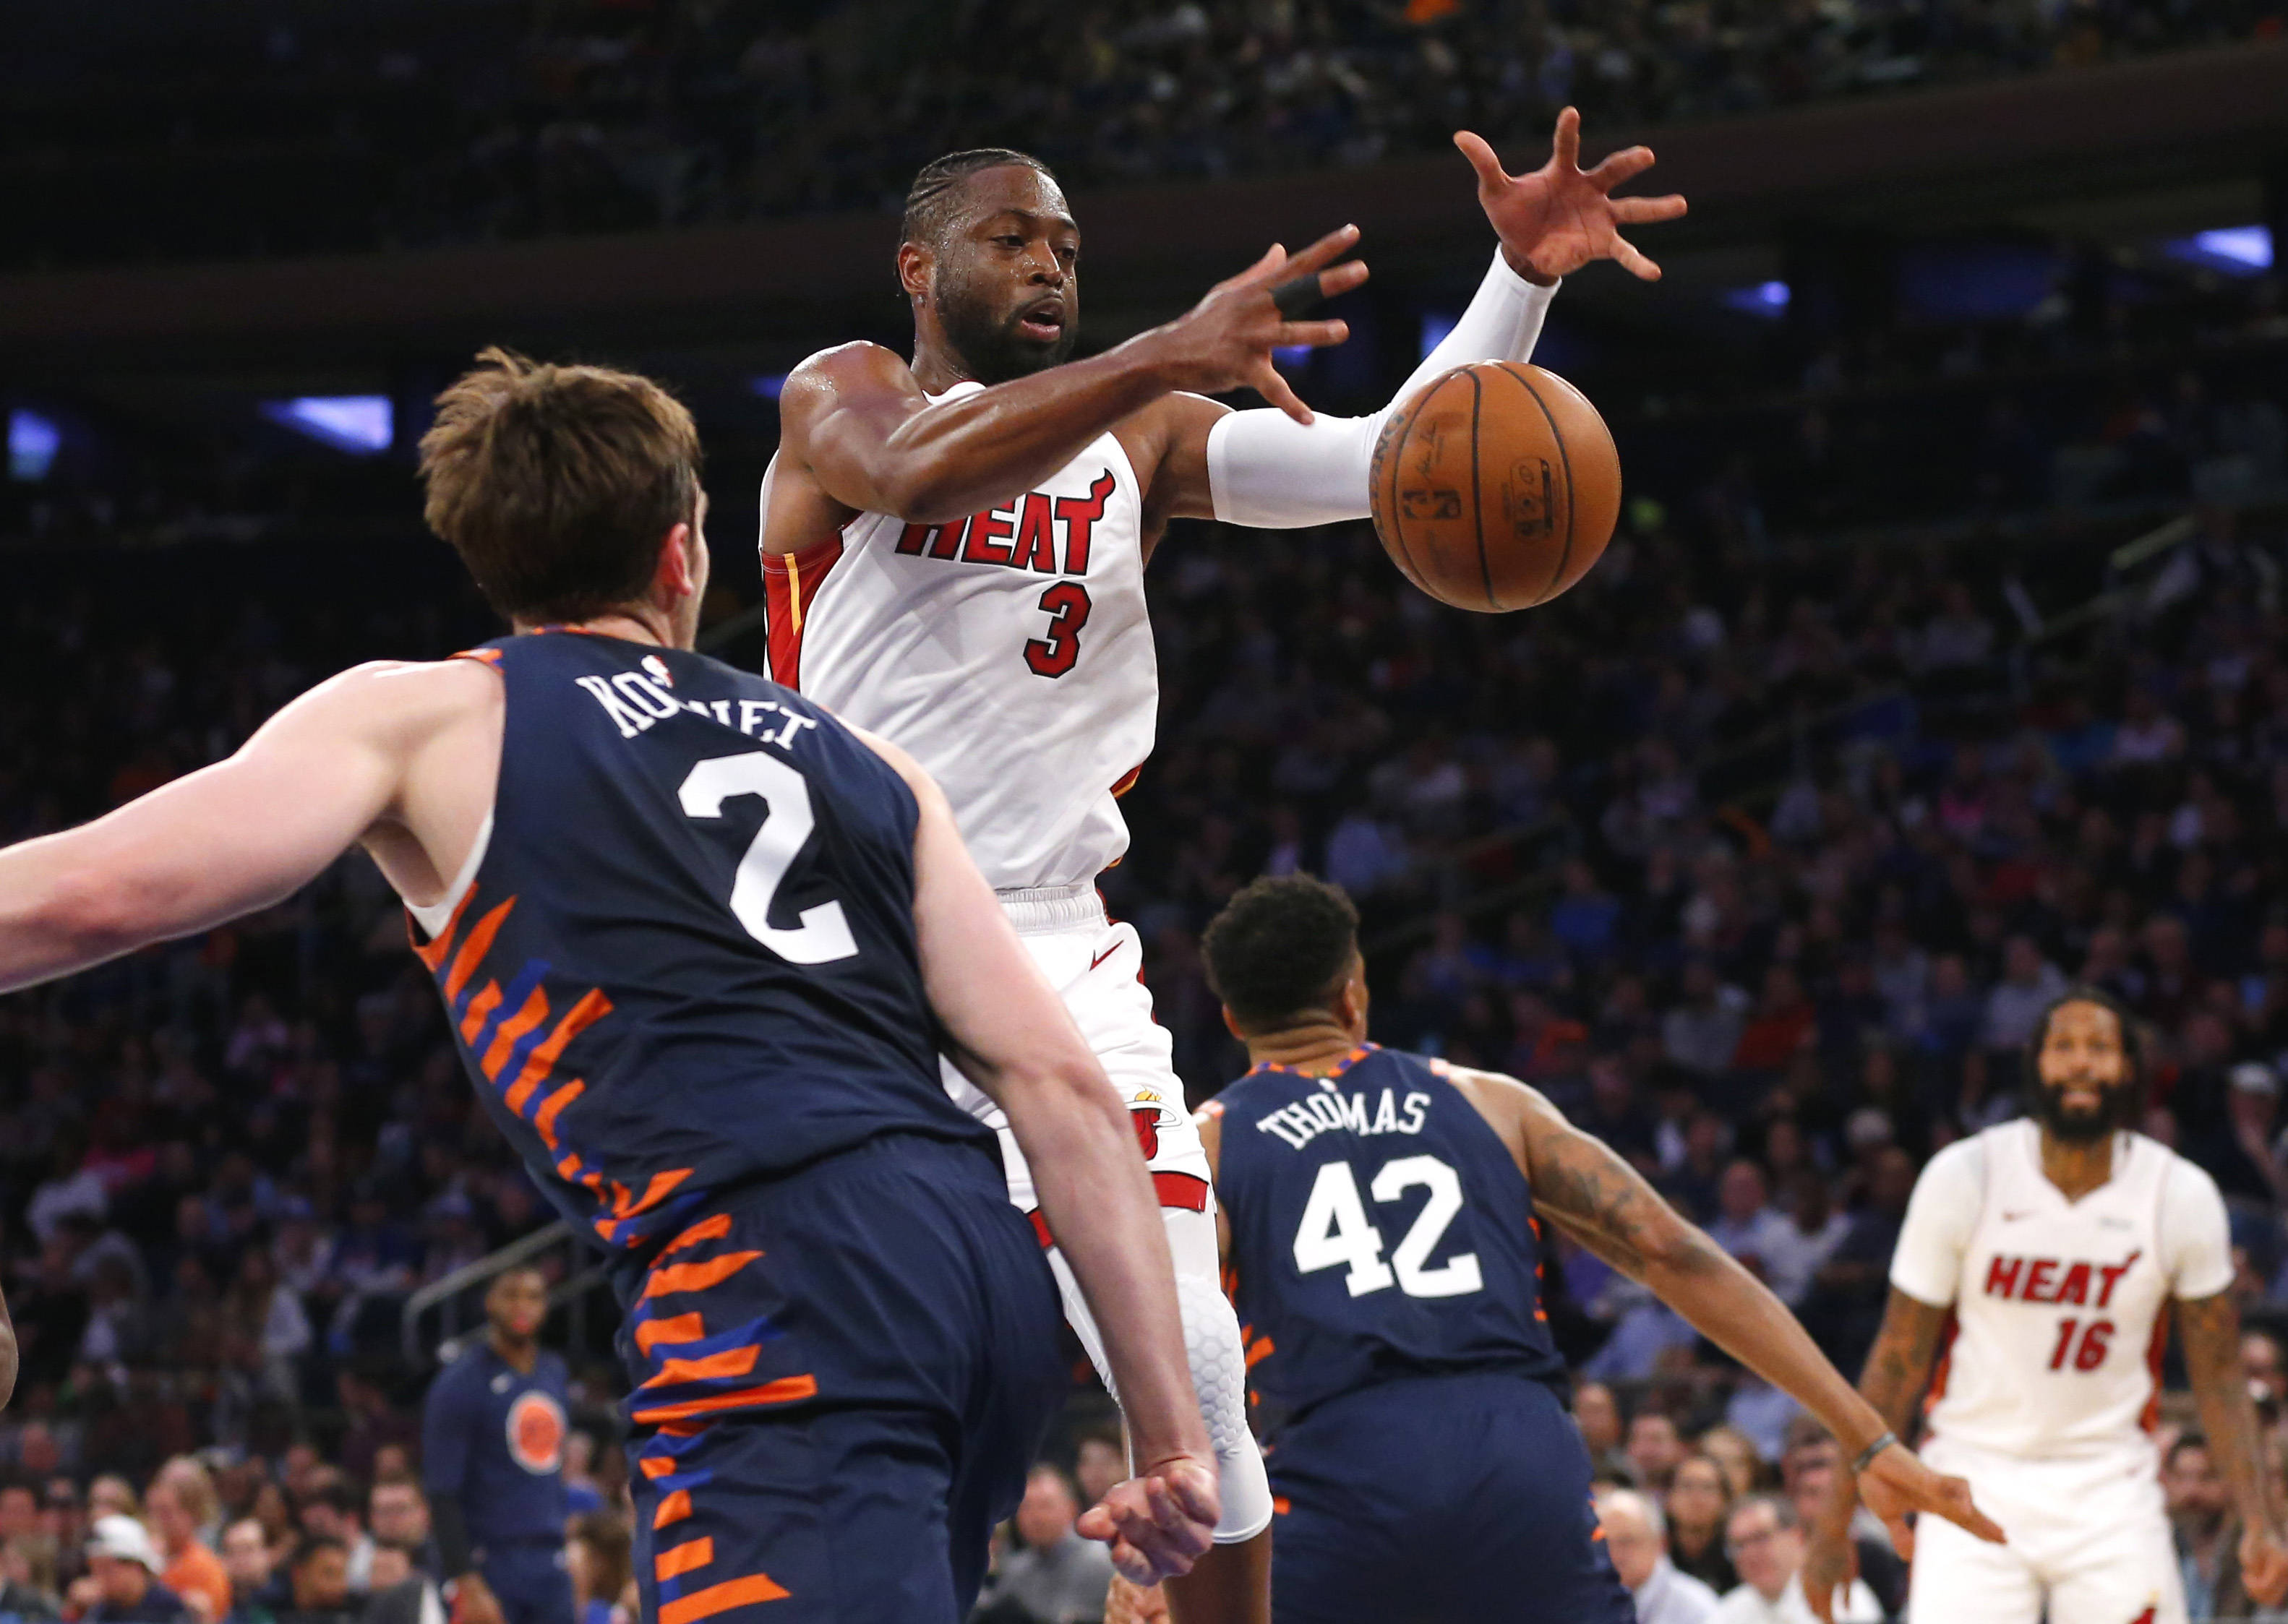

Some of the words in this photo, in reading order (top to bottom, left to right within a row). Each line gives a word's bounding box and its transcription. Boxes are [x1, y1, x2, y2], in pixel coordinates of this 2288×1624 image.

[1023, 580, 1092, 679] 3
[677, 750, 859, 964] 2
[1256, 1088, 1431, 1150] THOMAS
[1293, 1154, 1483, 1298] 42
[1985, 1247, 2141, 1308] HEAT
[2049, 1318, 2115, 1371] 16
